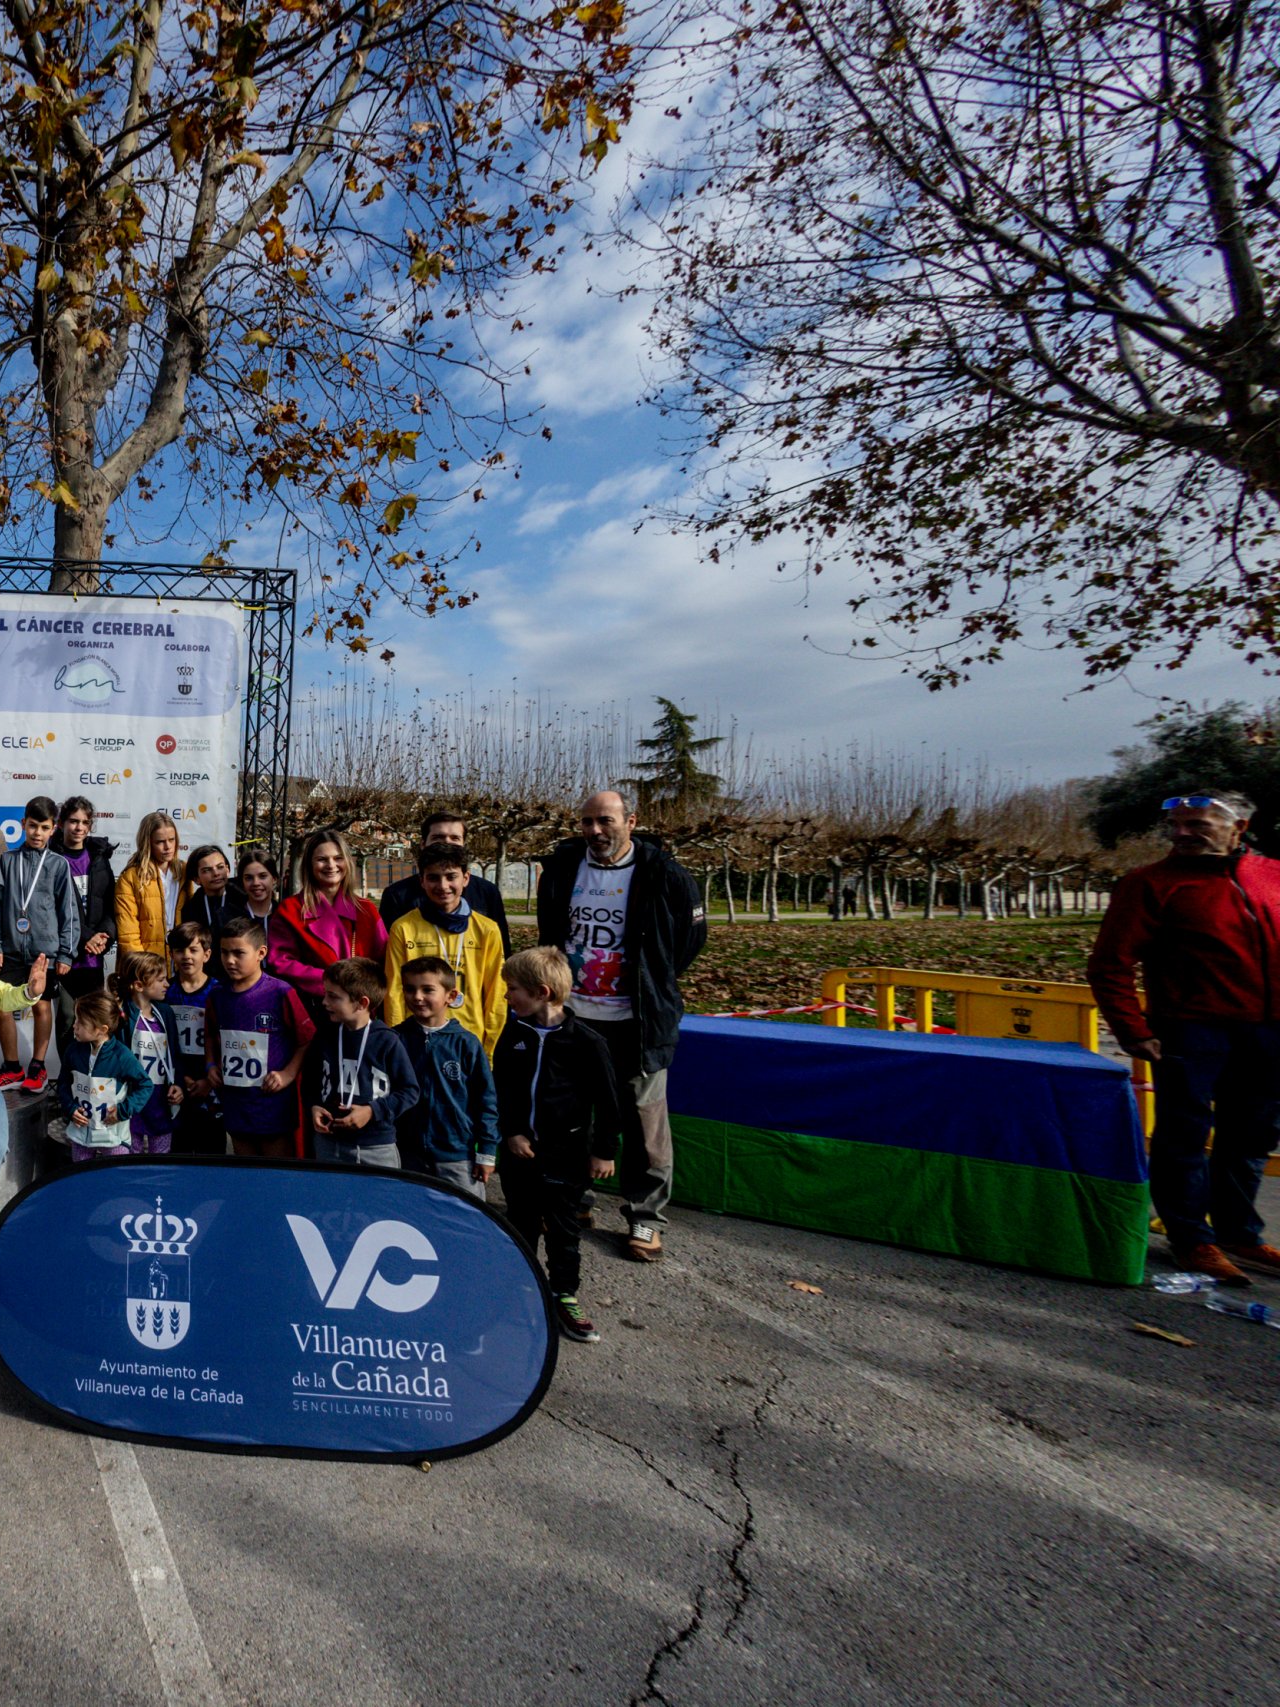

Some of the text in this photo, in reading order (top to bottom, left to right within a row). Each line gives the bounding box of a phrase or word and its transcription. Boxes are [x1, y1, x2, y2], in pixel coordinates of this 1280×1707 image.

[16, 616, 84, 633] CÁNCER
[92, 621, 175, 637] CEREBRAL
[67, 640, 114, 649] ORGANIZA
[164, 644, 210, 652] COLABORA
[1, 736, 44, 749] ELEIA
[94, 738, 135, 746] INDRA
[159, 740, 173, 749] QP
[80, 773, 121, 785] ELEIA
[170, 772, 210, 781] INDRA
[569, 923, 624, 951] VID
[285, 1214, 440, 1313] VC
[290, 1323, 447, 1363] Villanueva
[99, 1358, 219, 1381] Ayuntamiento de
[292, 1361, 450, 1398] de la Cañada
[75, 1378, 244, 1405] Villanueva de la Cañada
[292, 1400, 453, 1422] SENCILLAMENTE TODO
